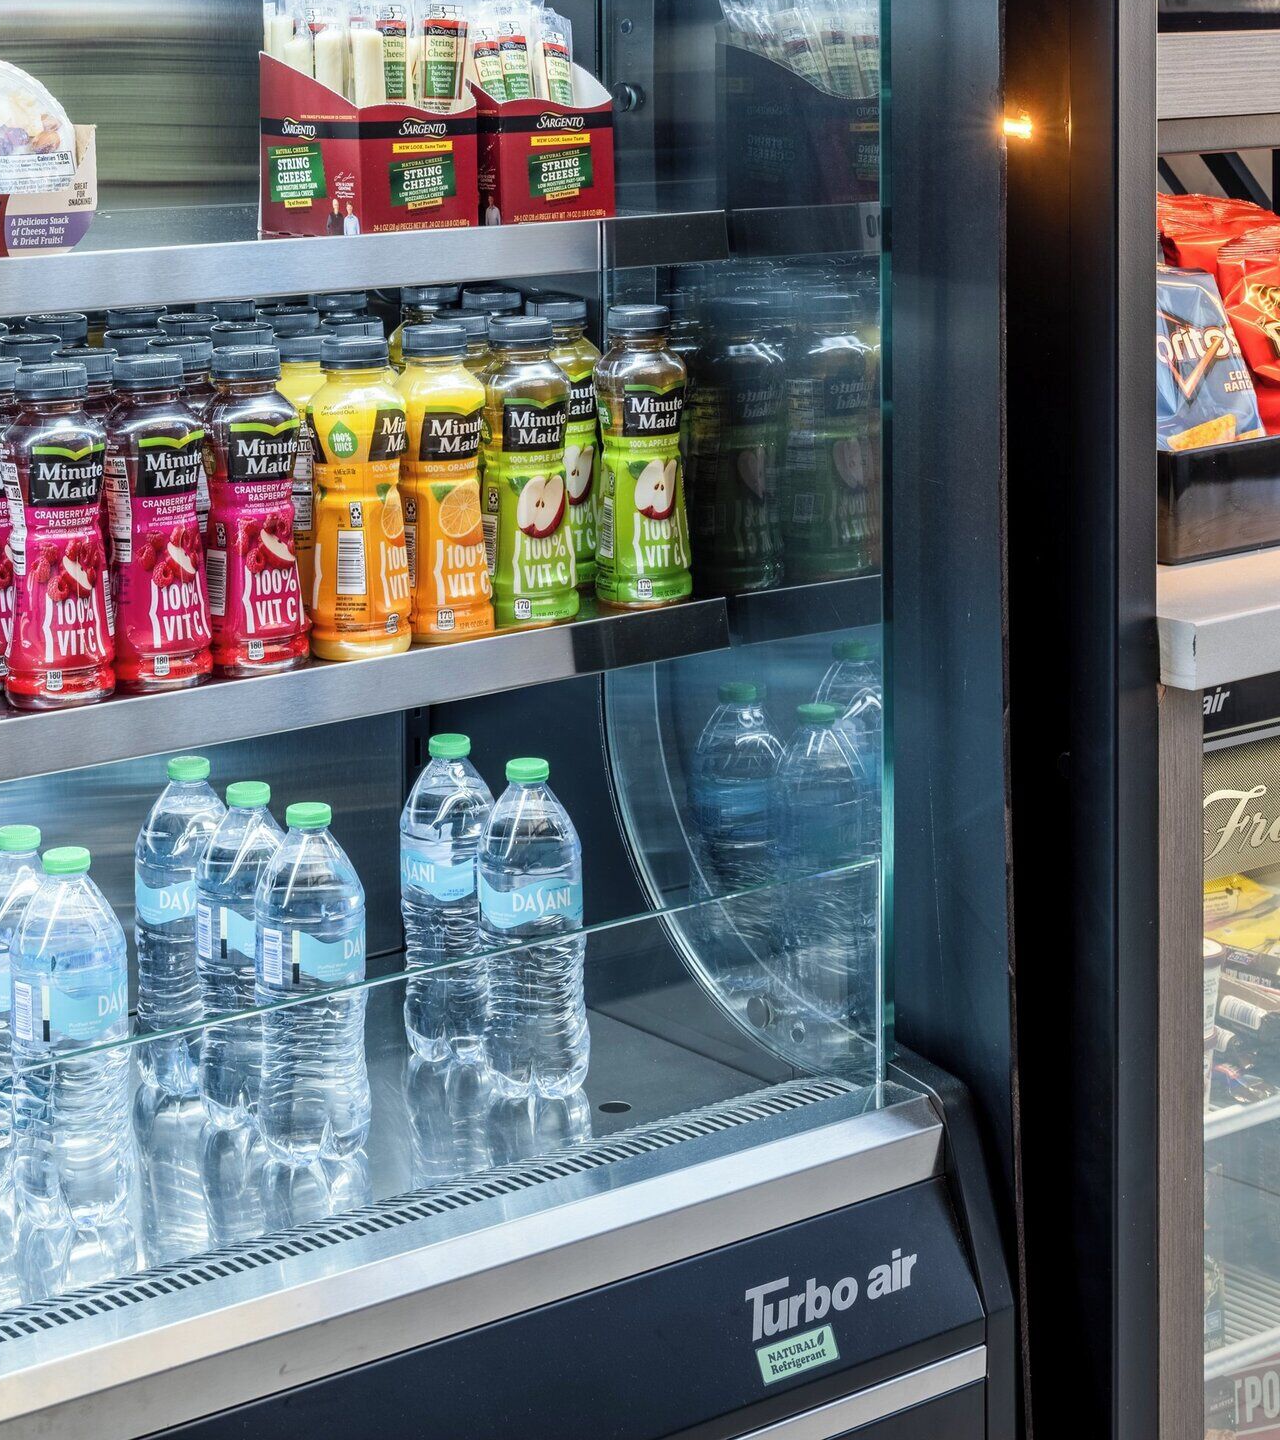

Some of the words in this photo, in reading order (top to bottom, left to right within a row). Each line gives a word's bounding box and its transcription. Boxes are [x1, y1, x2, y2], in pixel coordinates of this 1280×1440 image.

[399, 121, 446, 136] SARGENTO
[536, 114, 584, 130] SARGENTO
[403, 166, 442, 181] STRING
[541, 158, 579, 172] STRING
[403, 177, 443, 190] CHEESE
[540, 169, 580, 182] CHEESE
[1156, 326, 1238, 362] oritos
[630, 397, 682, 413] Minute
[510, 412, 566, 428] Minute
[638, 413, 677, 429] Maid
[518, 428, 559, 444] Maid
[236, 439, 297, 458] Minute
[334, 442, 353, 452] JUICE
[438, 437, 479, 454] Maid
[146, 452, 202, 472] Minute
[246, 457, 291, 474] Maid
[38, 462, 102, 481] Minute
[154, 471, 197, 489] Maid
[47, 481, 96, 500] Maid
[248, 491, 287, 502] RASPBERRY
[35, 510, 79, 519] CRANBERRY
[48, 517, 93, 527] RASPBERRY
[524, 535, 565, 560] 100%
[254, 566, 296, 596] 100%
[56, 599, 93, 626] 100%
[439, 611, 452, 620] 170
[1203, 688, 1230, 715] air
[511, 890, 572, 918] DASANI
[744, 1276, 858, 1342] Turbo
[866, 1248, 917, 1300] air
[768, 1338, 817, 1364] NATURAL
[770, 1348, 826, 1375] Refrigerant
